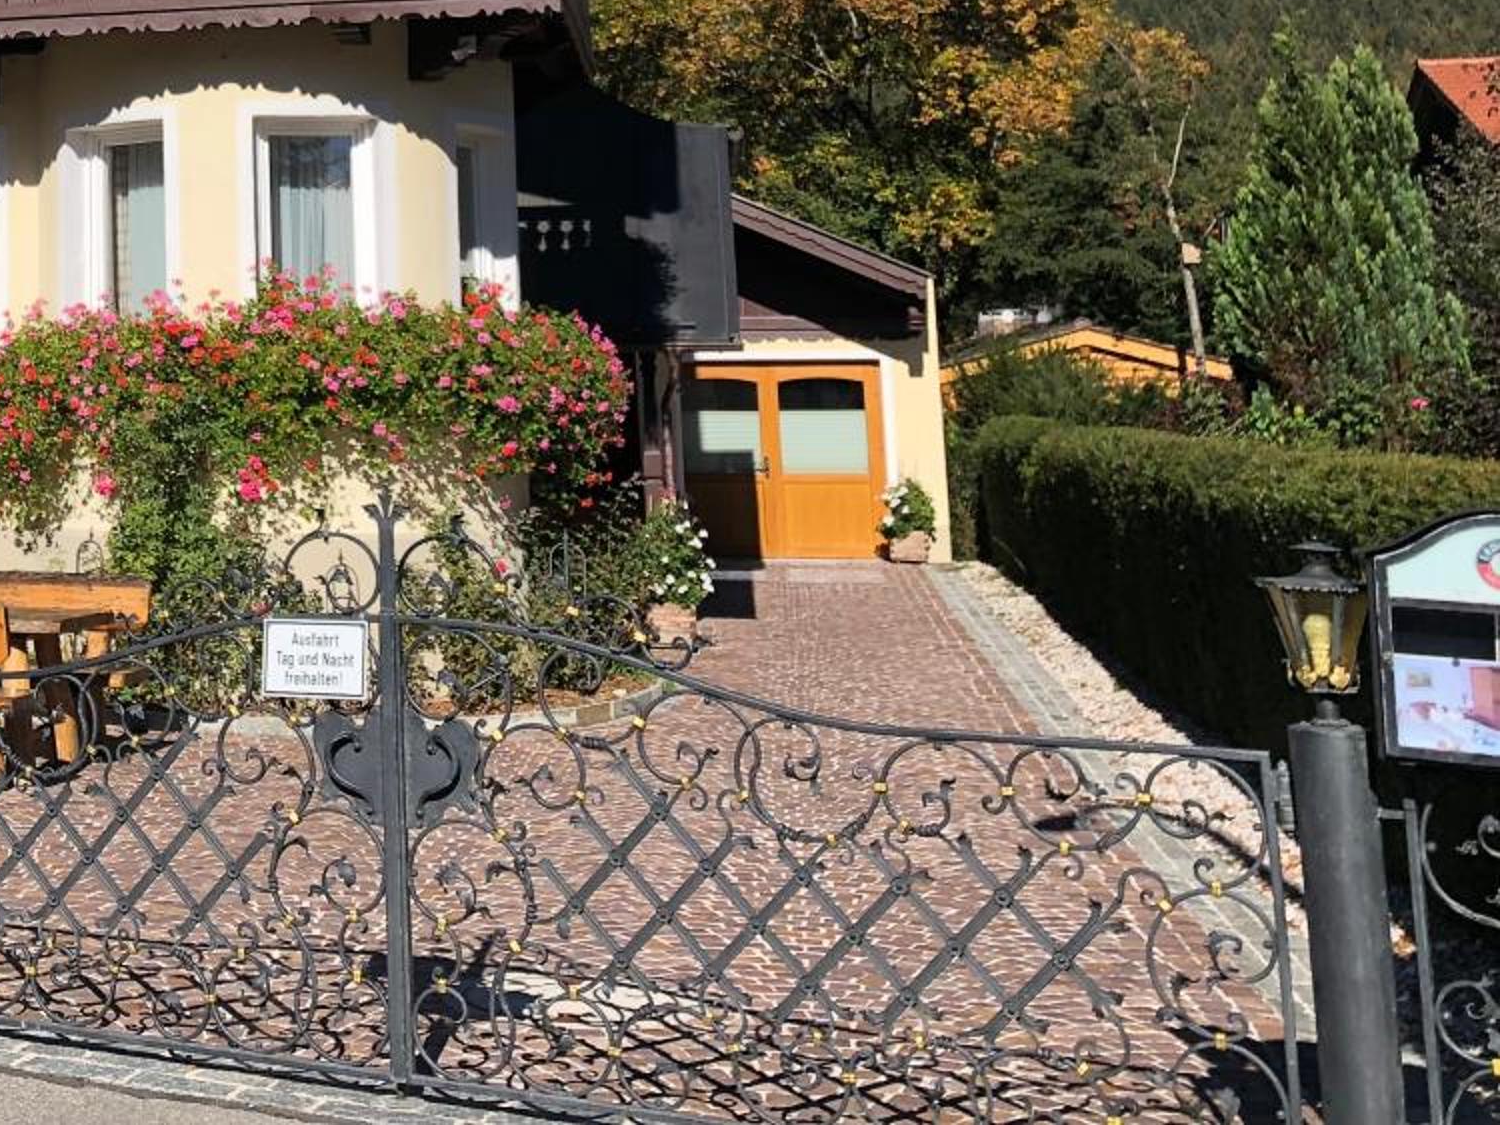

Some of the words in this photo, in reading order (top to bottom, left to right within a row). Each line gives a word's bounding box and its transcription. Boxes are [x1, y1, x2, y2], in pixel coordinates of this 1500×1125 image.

[291, 632, 340, 647] Ausfahrt
[277, 650, 295, 669] Tag
[298, 653, 319, 666] und
[322, 652, 355, 668] Nacht
